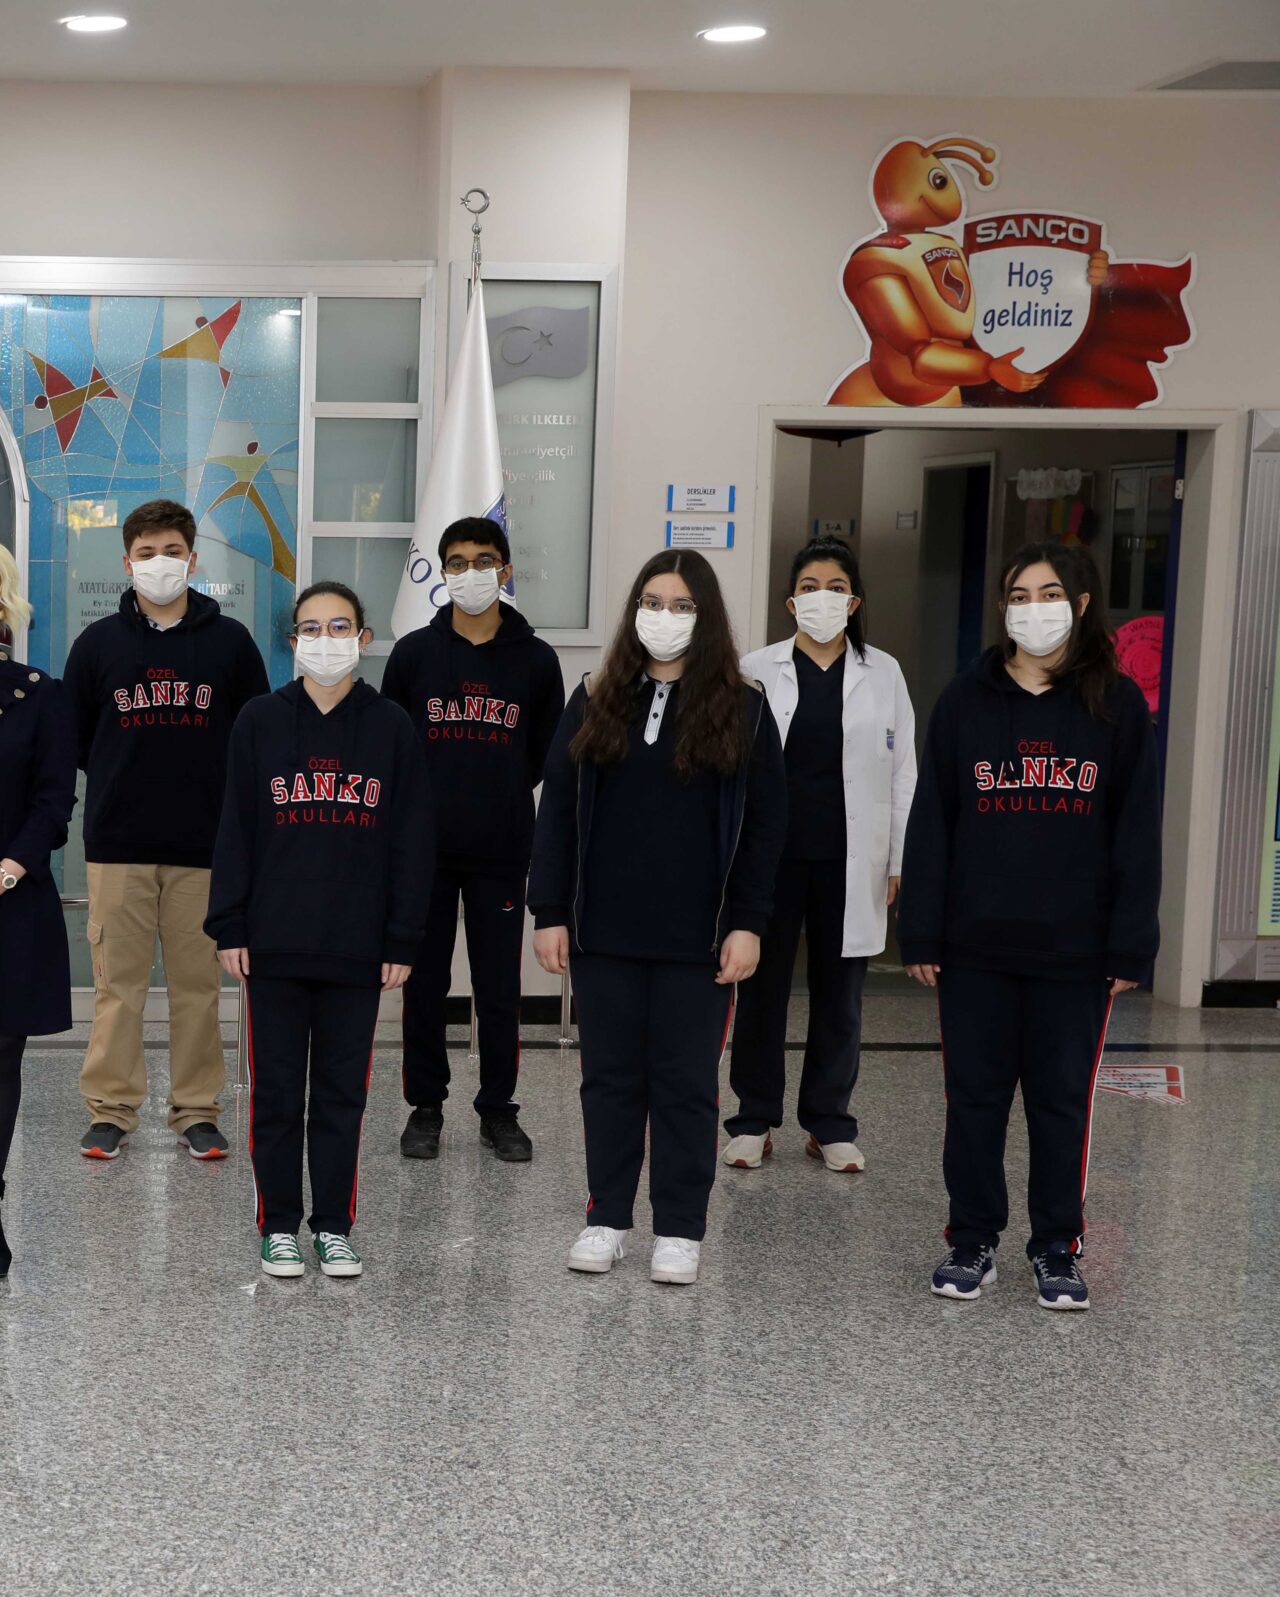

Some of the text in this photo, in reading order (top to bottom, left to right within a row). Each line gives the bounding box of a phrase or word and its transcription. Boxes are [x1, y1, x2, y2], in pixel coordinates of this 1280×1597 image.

[975, 218, 1089, 244] SANÇO
[924, 248, 958, 263] SANÇO
[1008, 262, 1053, 295] Hoş
[982, 301, 1073, 334] geldiniz
[147, 667, 179, 679] ÖZEL
[114, 681, 212, 712] SANKO
[462, 680, 492, 695] ÖZEL
[120, 712, 209, 728] OKULLARI
[427, 696, 520, 729] SANKO
[1017, 738, 1057, 754] ÖZEL
[308, 756, 344, 770] ÖZEL
[974, 757, 1098, 792] SANKO
[270, 772, 380, 808] SANKO
[977, 795, 1093, 816] OKULLARI
[275, 808, 376, 829] OKULLARI
